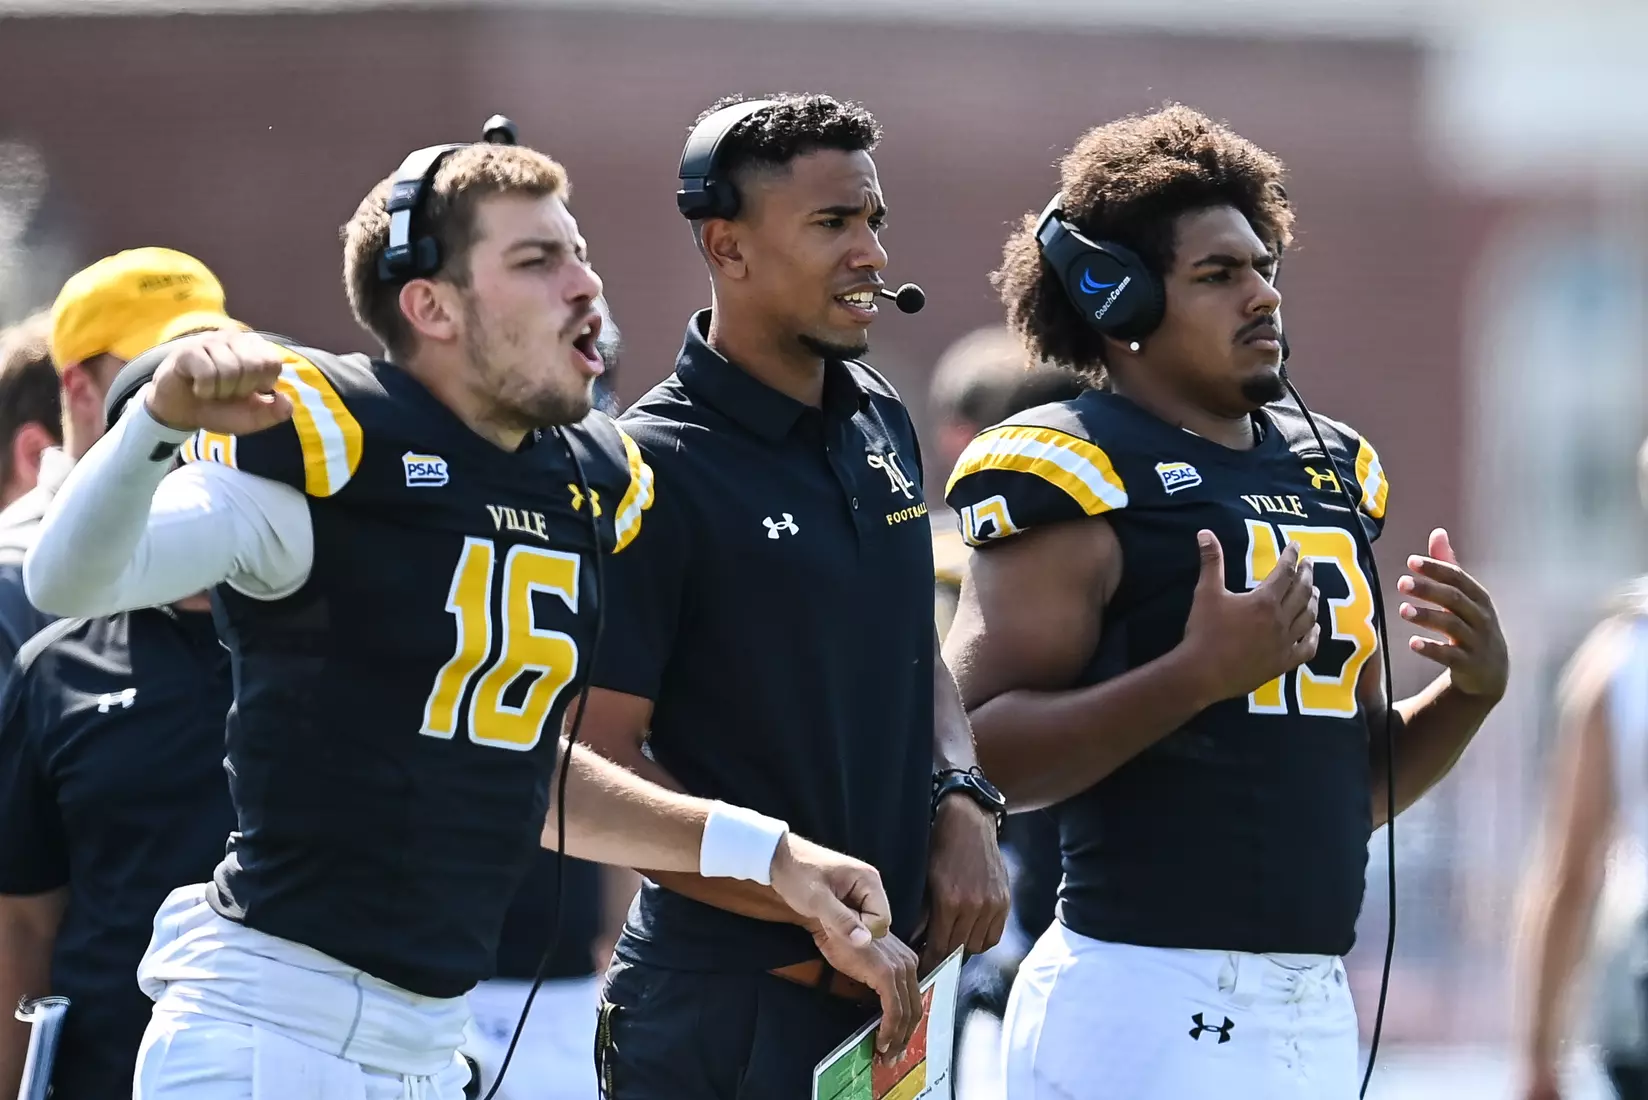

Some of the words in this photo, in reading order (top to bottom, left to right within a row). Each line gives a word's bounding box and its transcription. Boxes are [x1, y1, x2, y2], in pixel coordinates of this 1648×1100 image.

[1094, 275, 1132, 320] CoachComm
[407, 462, 445, 477] PSAC
[1161, 467, 1198, 484] PSAC
[1240, 494, 1309, 519] VILLE
[485, 504, 550, 541] VILLE
[418, 535, 581, 752] 16
